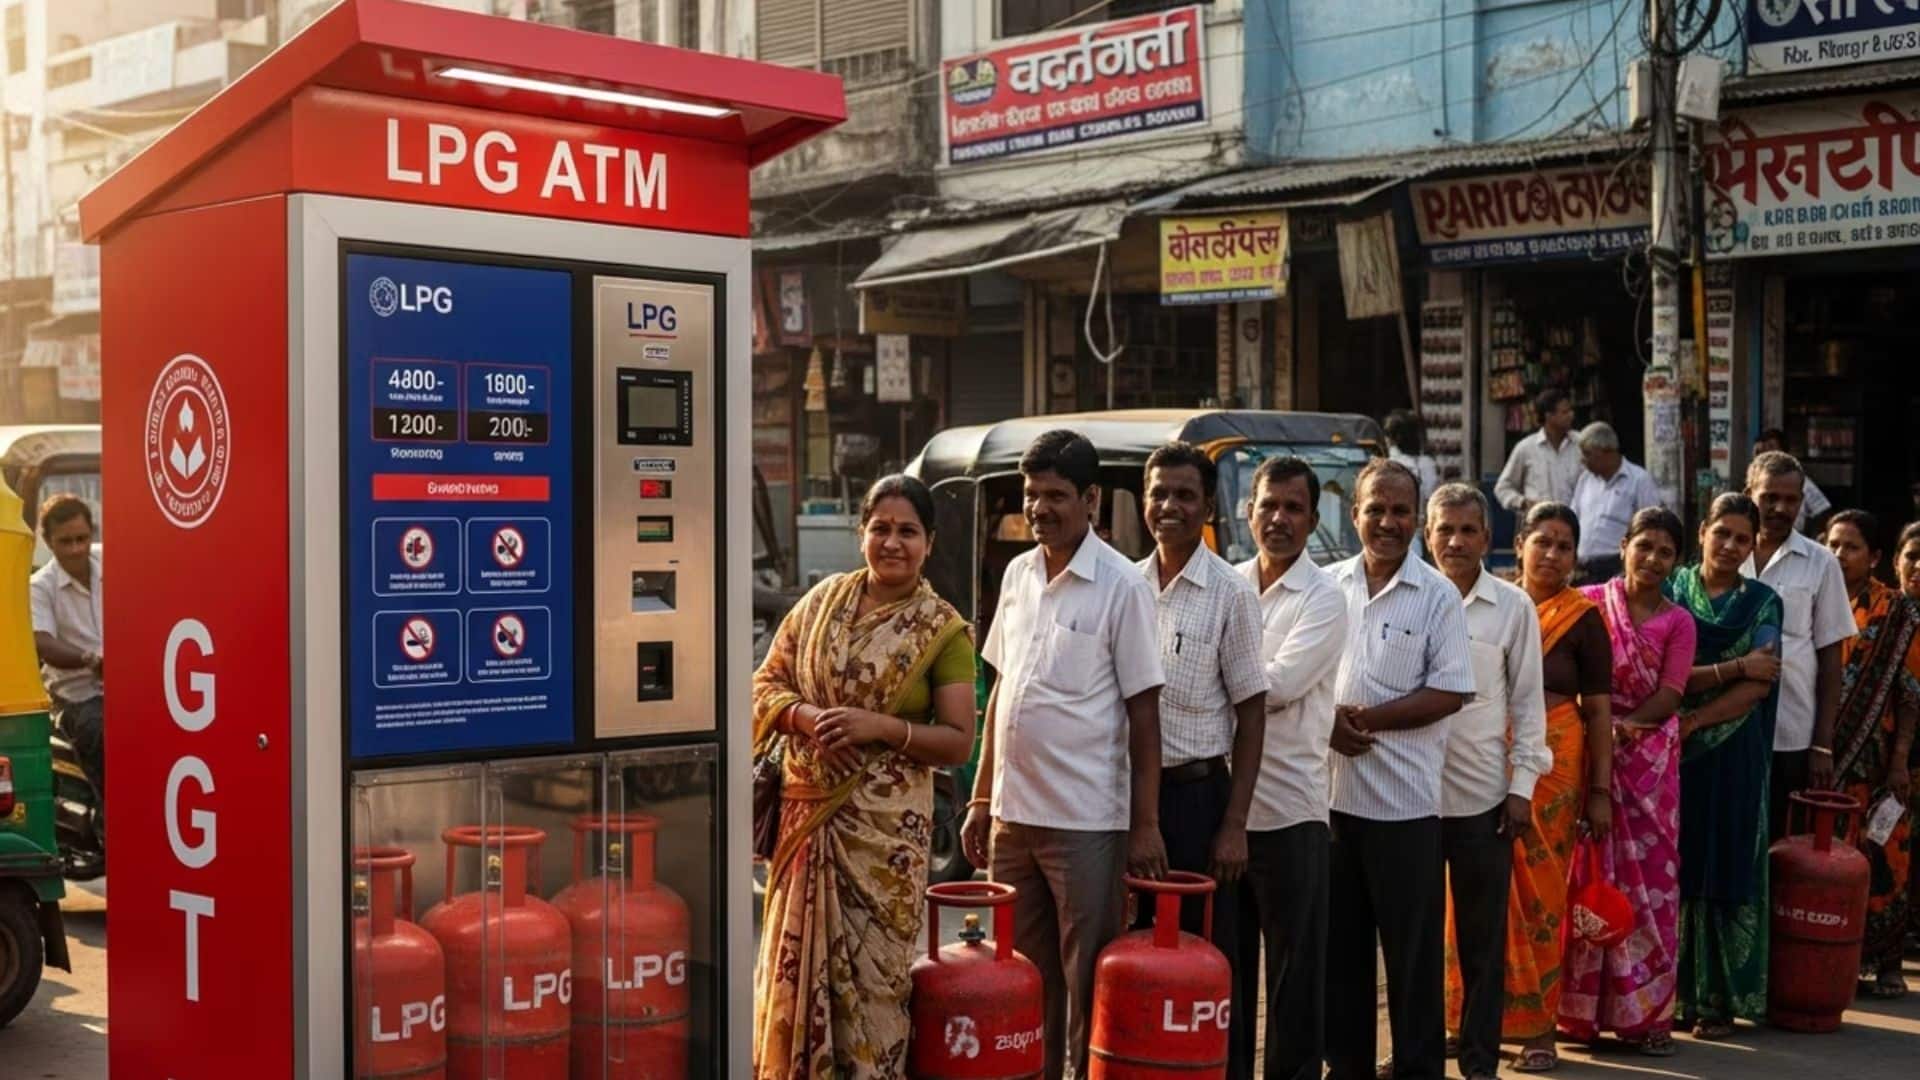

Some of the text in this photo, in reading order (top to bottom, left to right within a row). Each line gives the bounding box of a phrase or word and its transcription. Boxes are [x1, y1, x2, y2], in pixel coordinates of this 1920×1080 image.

[387, 117, 668, 211] LPG ATM
[401, 283, 454, 314] LPG
[627, 301, 677, 332] LPG
[503, 969, 572, 1012] LPG
[371, 995, 446, 1042] LPG
[1162, 999, 1231, 1034] LPG
